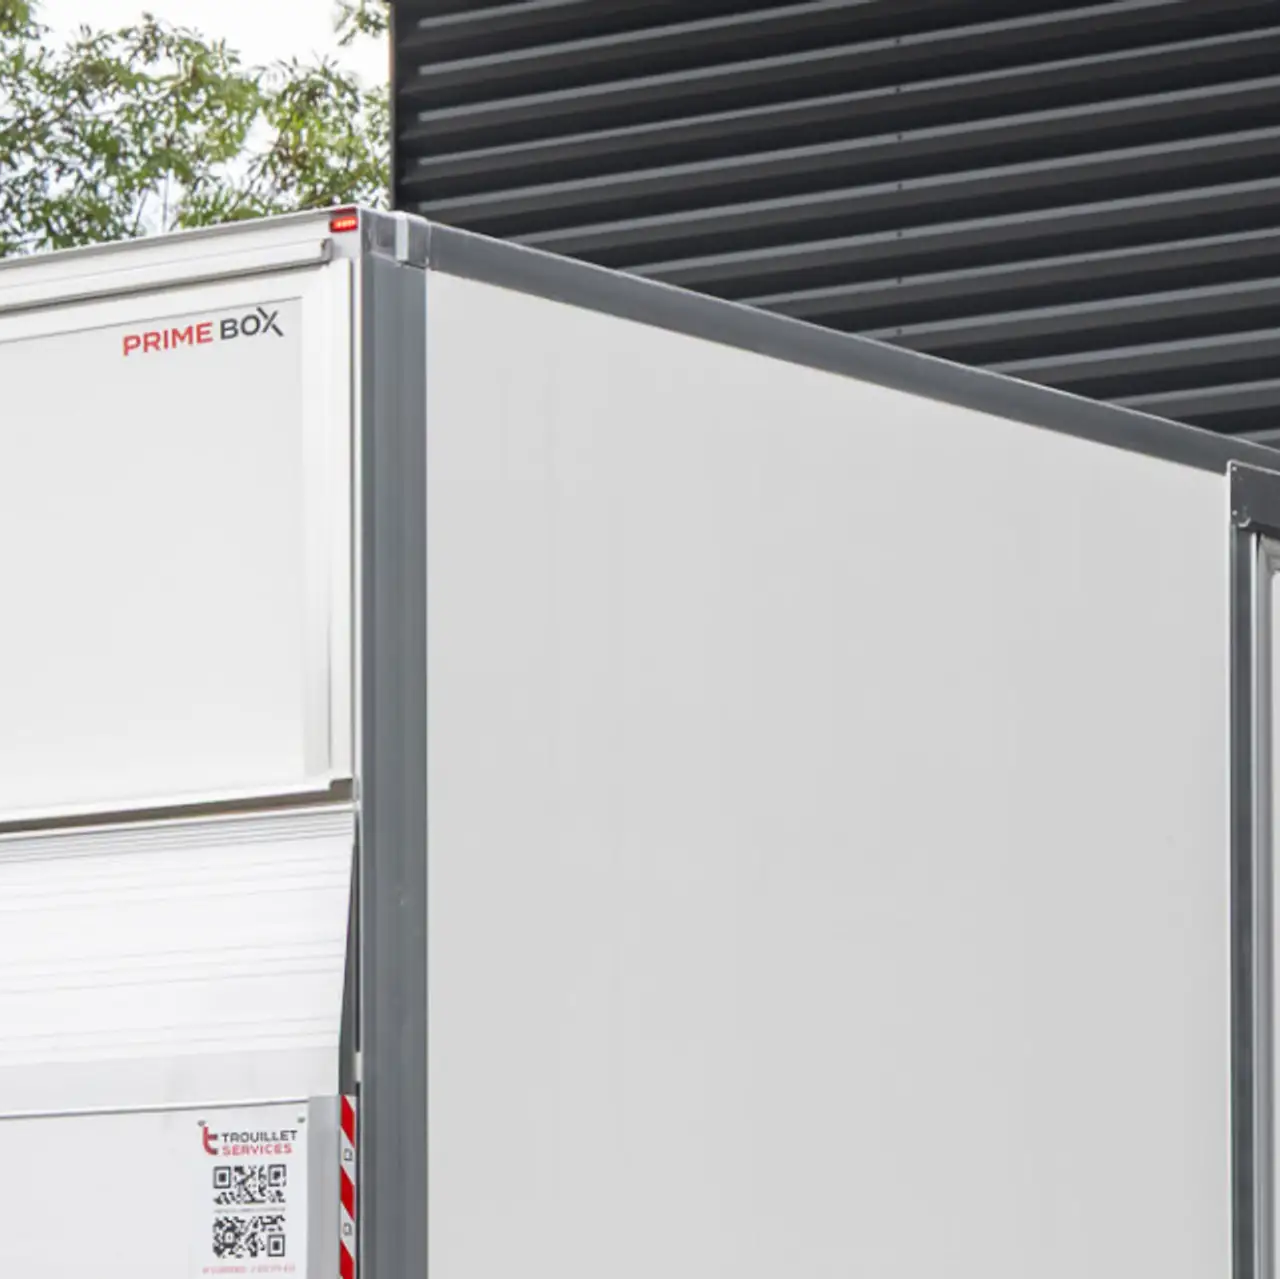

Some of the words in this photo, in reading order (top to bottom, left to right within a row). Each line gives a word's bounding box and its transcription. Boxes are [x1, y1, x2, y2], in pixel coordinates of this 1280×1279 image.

[122, 321, 214, 356] PRIME
[220, 306, 284, 341] BOX
[221, 1130, 298, 1144] TROUILLET
[222, 1143, 294, 1157] SERVICES
